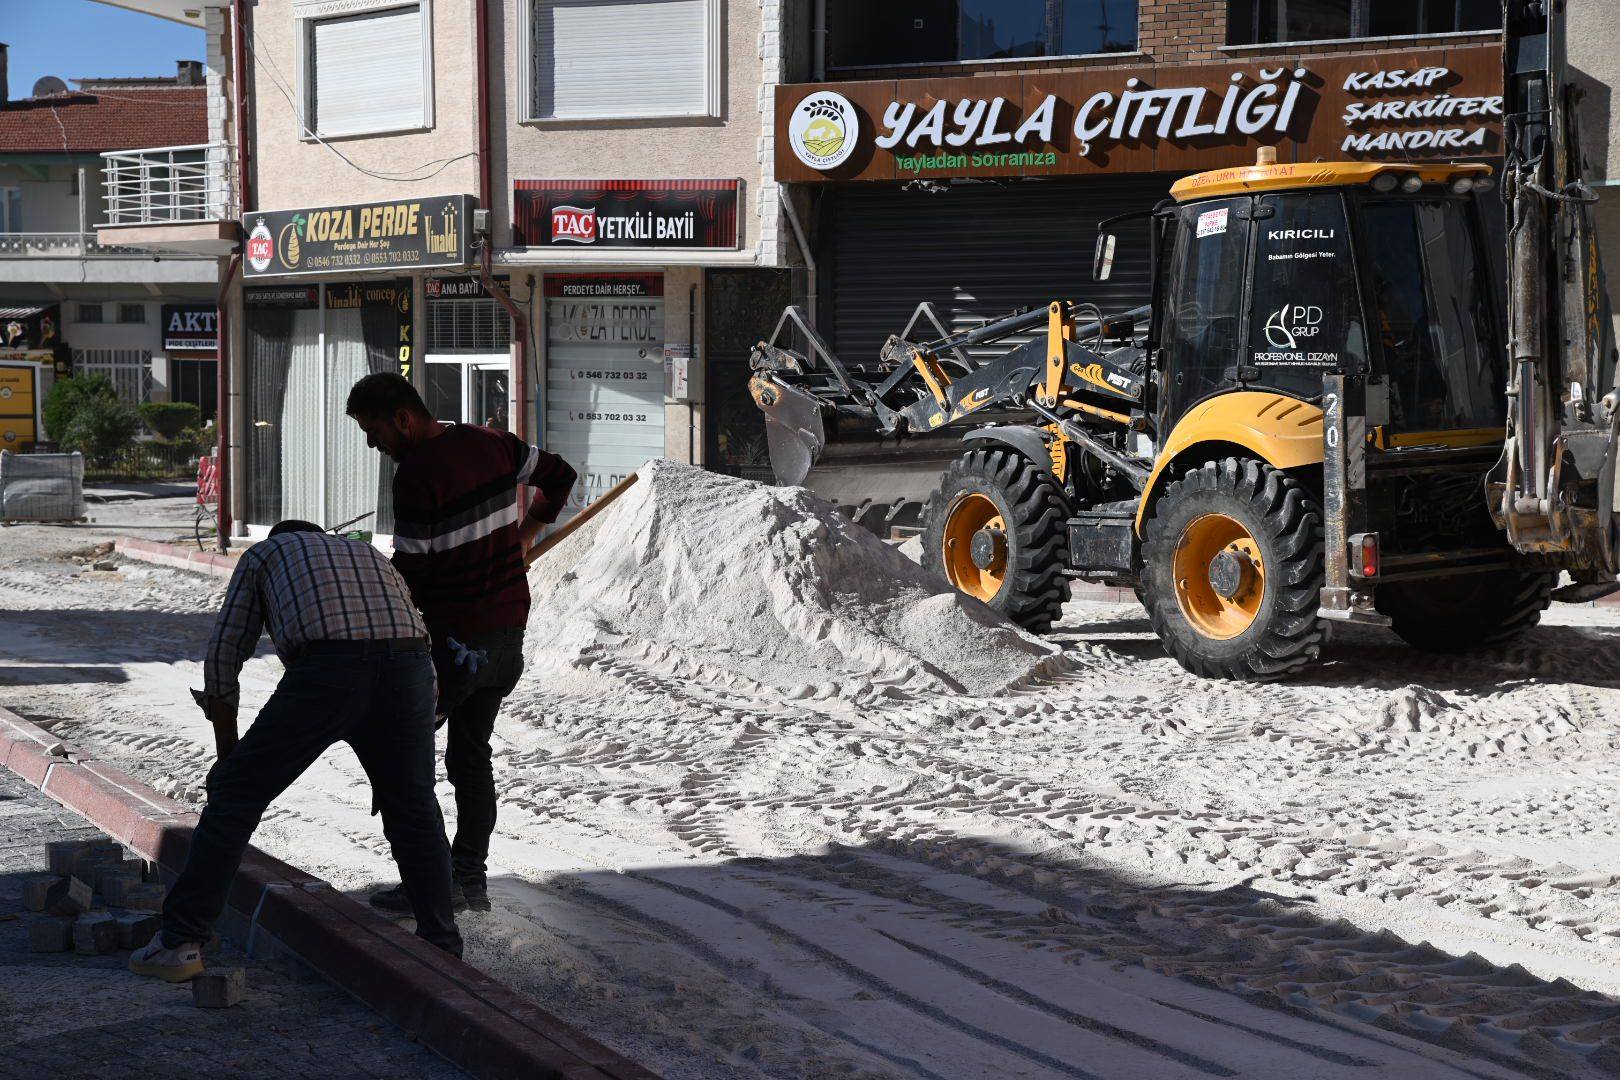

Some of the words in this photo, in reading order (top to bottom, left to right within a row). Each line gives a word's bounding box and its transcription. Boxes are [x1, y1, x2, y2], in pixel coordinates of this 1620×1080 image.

[1342, 67, 1449, 91] KASAP
[874, 94, 1056, 148] YAYLA
[1073, 67, 1306, 156] ÇİFTLİĞİ
[1341, 127, 1486, 151] MANDIRA
[896, 152, 967, 174] Yayladan
[972, 151, 1056, 168] Sofranıza
[306, 209, 353, 243] KOZA
[359, 203, 421, 239] PERDE
[554, 214, 593, 238] TAÇ
[597, 211, 652, 239] YETKİLİ
[656, 212, 694, 239] BAYİİ
[424, 214, 458, 253] Vinaldi
[1268, 229, 1335, 240] KIRICILI
[251, 243, 270, 256] TAÇ
[314, 257, 330, 267] 0546
[331, 255, 344, 266] 732
[344, 254, 361, 265] 0332
[371, 253, 387, 264] 0553
[388, 252, 402, 263] 702
[402, 250, 420, 262] 0332
[1294, 252, 1318, 261] Gölgesi
[327, 286, 362, 308] Vinaldi
[441, 284, 458, 295] ANA
[563, 285, 594, 295] PERDEYE
[595, 282, 612, 295] DAİR
[168, 312, 218, 332] AKT
[613, 305, 657, 341] PERDE
[1293, 306, 1323, 325] PD
[1291, 326, 1320, 337] GRUP
[1254, 352, 1306, 361] PROFESYONEL
[578, 371, 583, 379] 0
[586, 371, 602, 379] 546
[605, 371, 621, 379] 732
[636, 372, 648, 380] 32
[1107, 373, 1131, 389] MST
[605, 413, 621, 421] 702
[636, 414, 646, 422] 32
